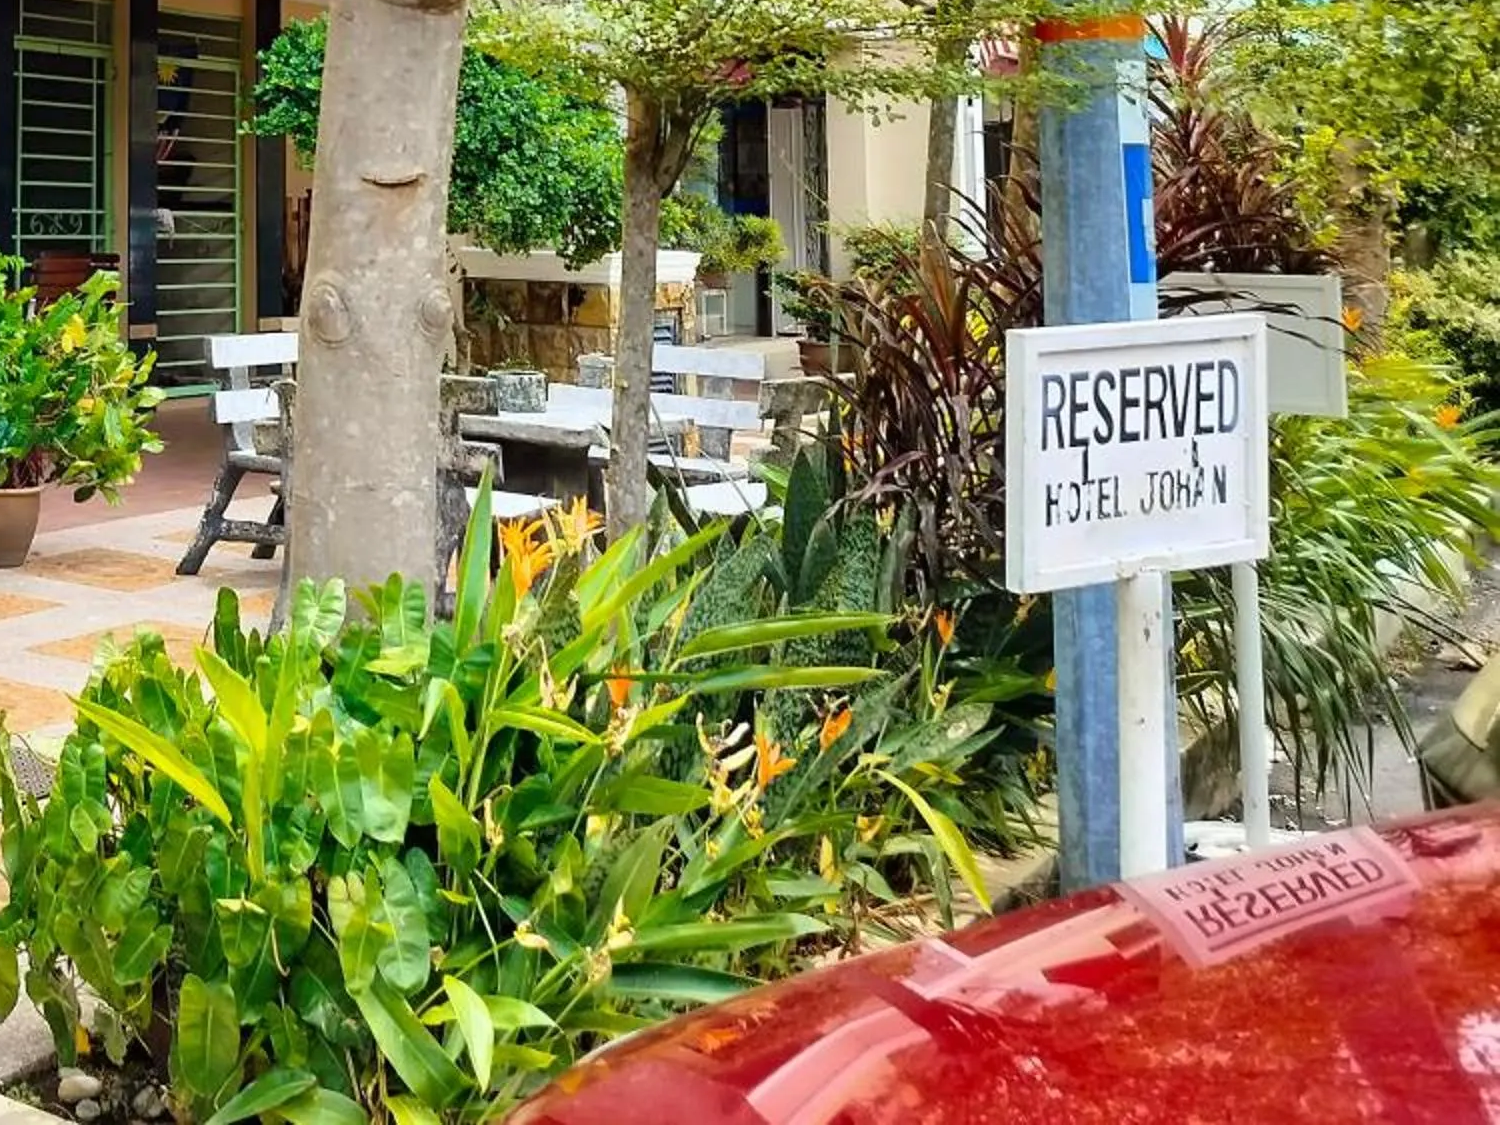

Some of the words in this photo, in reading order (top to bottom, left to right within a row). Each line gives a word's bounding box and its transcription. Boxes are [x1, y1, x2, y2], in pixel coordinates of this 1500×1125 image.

[1041, 360, 1239, 451] RESERVED
[1045, 476, 1126, 527] HOTEL
[1140, 465, 1227, 515] JOHAN
